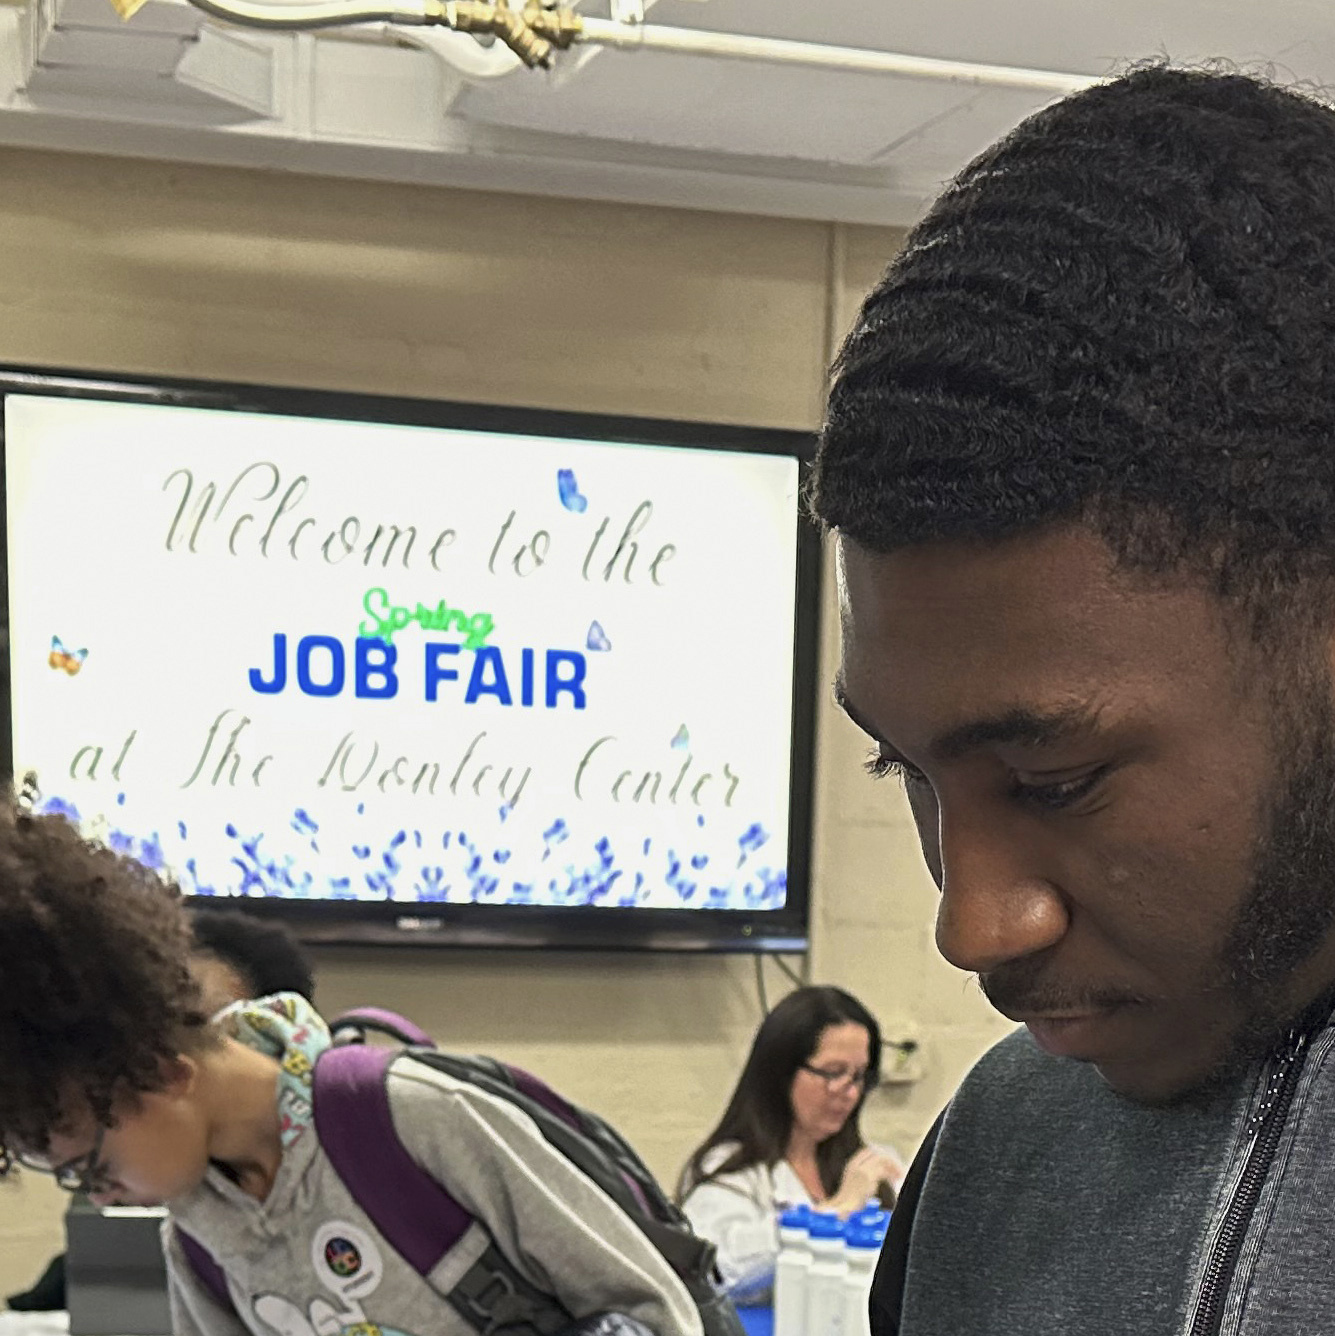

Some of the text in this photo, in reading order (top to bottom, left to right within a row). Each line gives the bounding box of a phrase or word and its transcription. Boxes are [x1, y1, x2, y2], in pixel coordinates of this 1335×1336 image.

[162, 461, 678, 587] Welcome to the
[358, 586, 497, 650] Spring
[247, 632, 588, 711] JOB FAIR
[69, 729, 137, 782] at
[574, 736, 740, 808] Center
